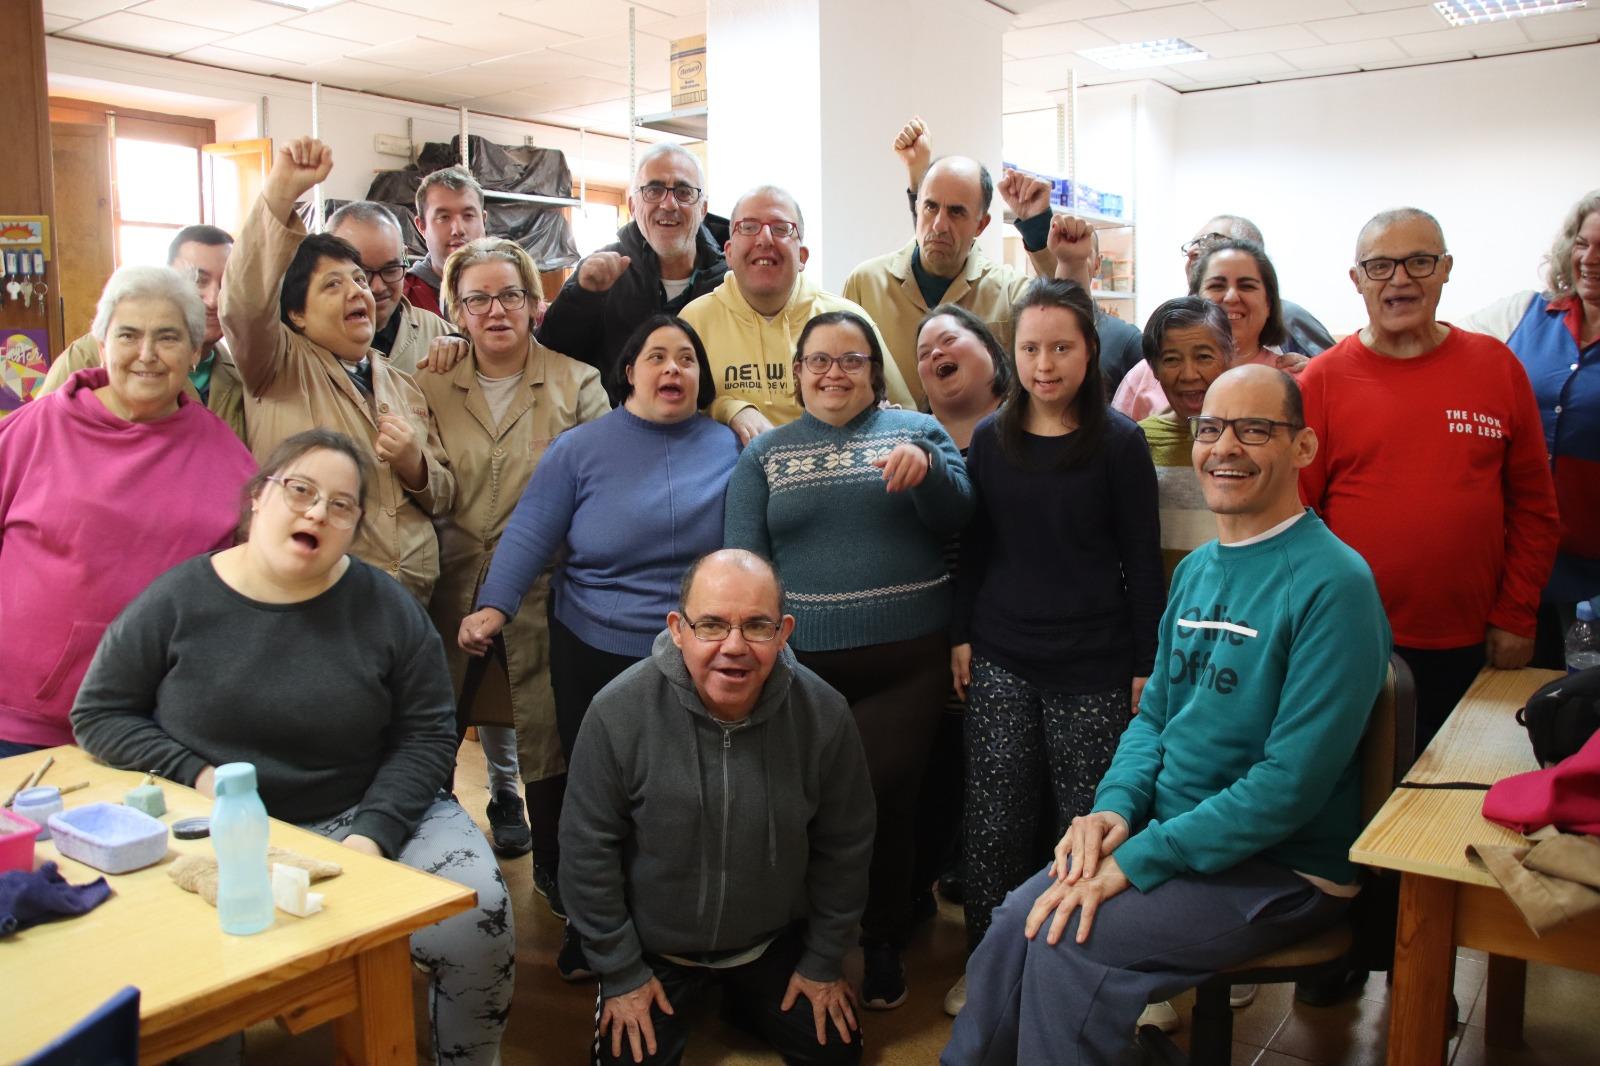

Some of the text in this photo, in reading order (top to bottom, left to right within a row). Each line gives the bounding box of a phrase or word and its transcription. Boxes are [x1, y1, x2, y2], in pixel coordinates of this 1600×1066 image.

[725, 363, 785, 382] NETW
[725, 381, 777, 390] WORLDWDE
[1445, 409, 1502, 428] THE LOOK
[1449, 422, 1503, 439] FOR LESS
[1169, 649, 1239, 695] Offne
